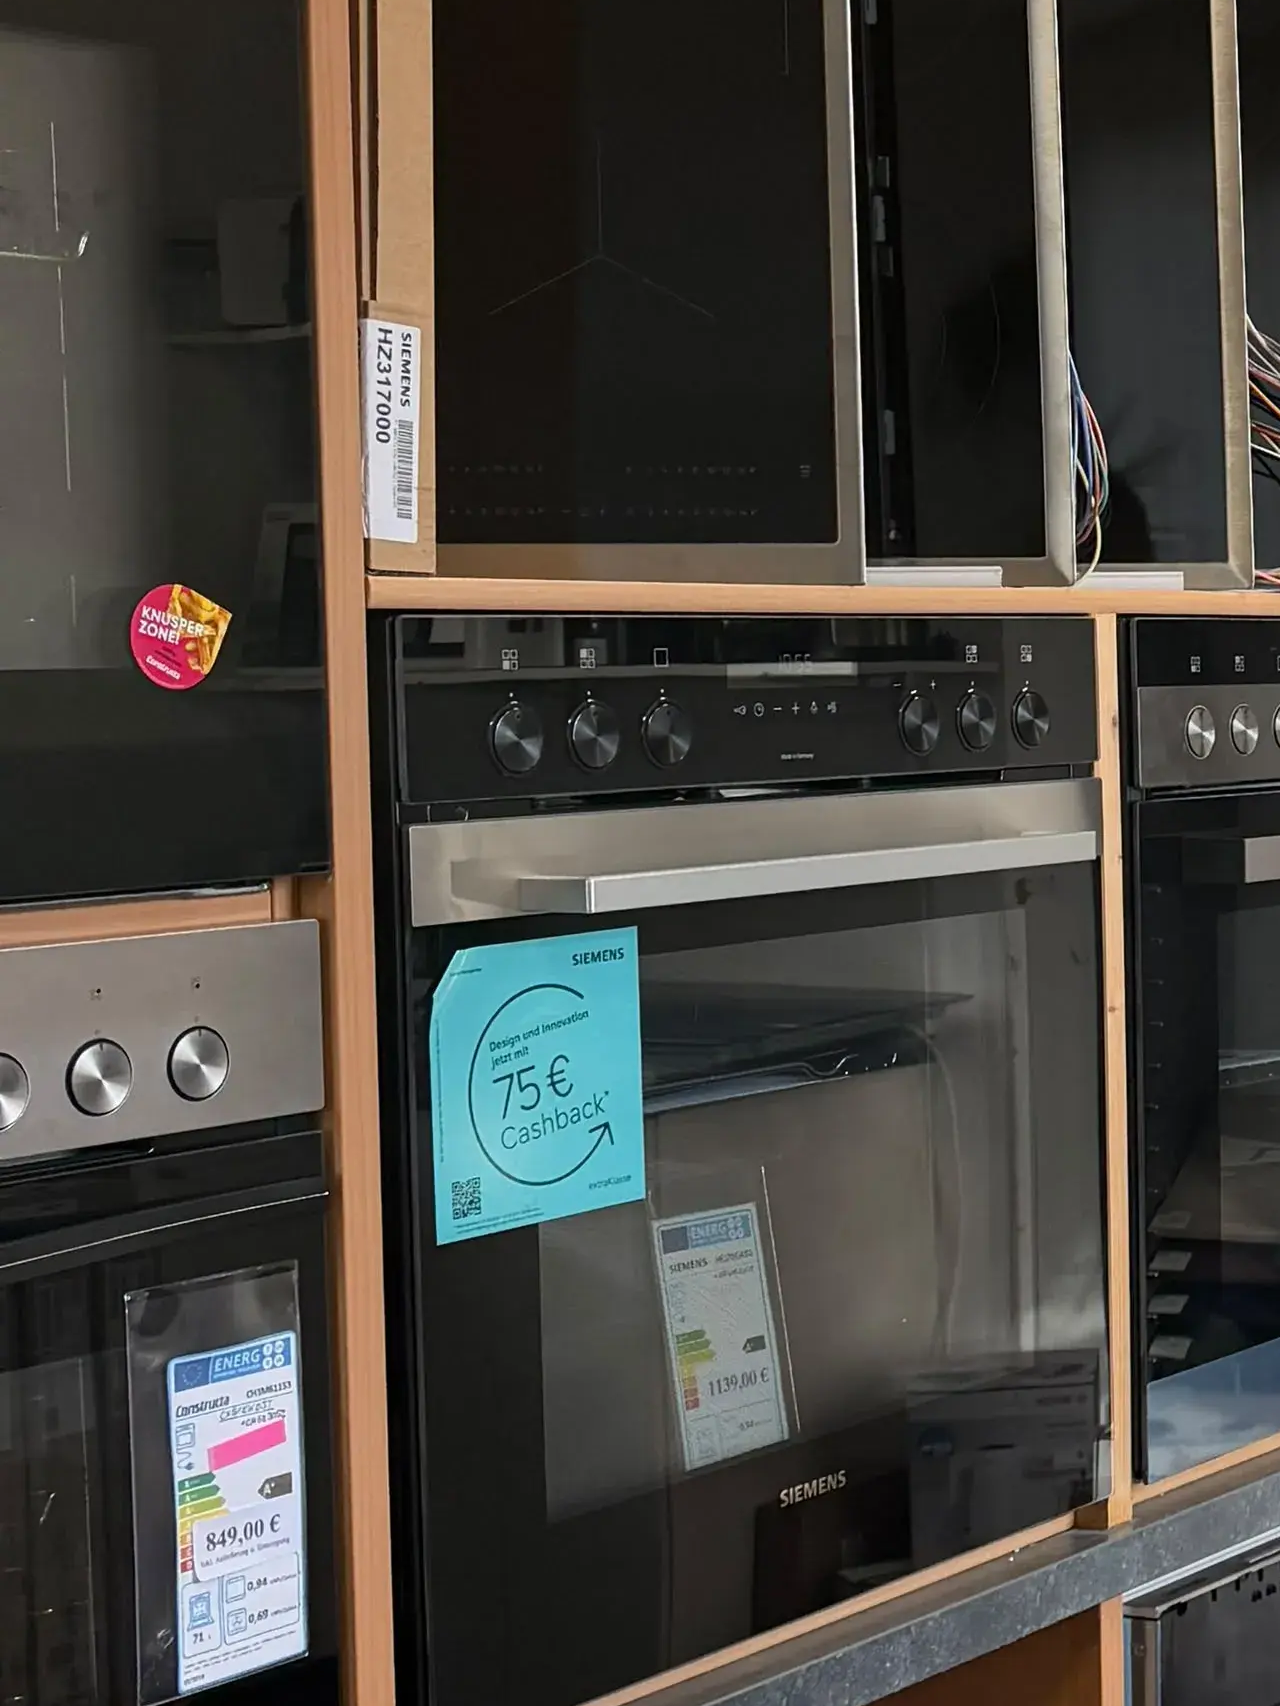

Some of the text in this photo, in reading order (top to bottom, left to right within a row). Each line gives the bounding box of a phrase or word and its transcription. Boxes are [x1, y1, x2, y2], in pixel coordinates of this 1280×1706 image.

[400, 331, 412, 408] SIEMENS
[376, 327, 393, 444] HZ317000
[138, 619, 180, 645] ZONE!
[141, 605, 204, 637] KNUSPER
[572, 947, 624, 966] SIEMENS
[489, 1009, 589, 1053] Design und Innovation
[491, 1046, 529, 1070] jetzt mit
[493, 1054, 574, 1120] 75 €
[668, 1258, 708, 1274] SIEMENS
[214, 1348, 261, 1373] ENERG
[760, 1367, 769, 1384] €
[176, 1395, 230, 1418] Constructa
[780, 1470, 847, 1508] SIEMENS
[206, 1513, 281, 1552] 849,00 €
[247, 1577, 268, 1592] 0,94
[248, 1609, 268, 1625] 0,69
